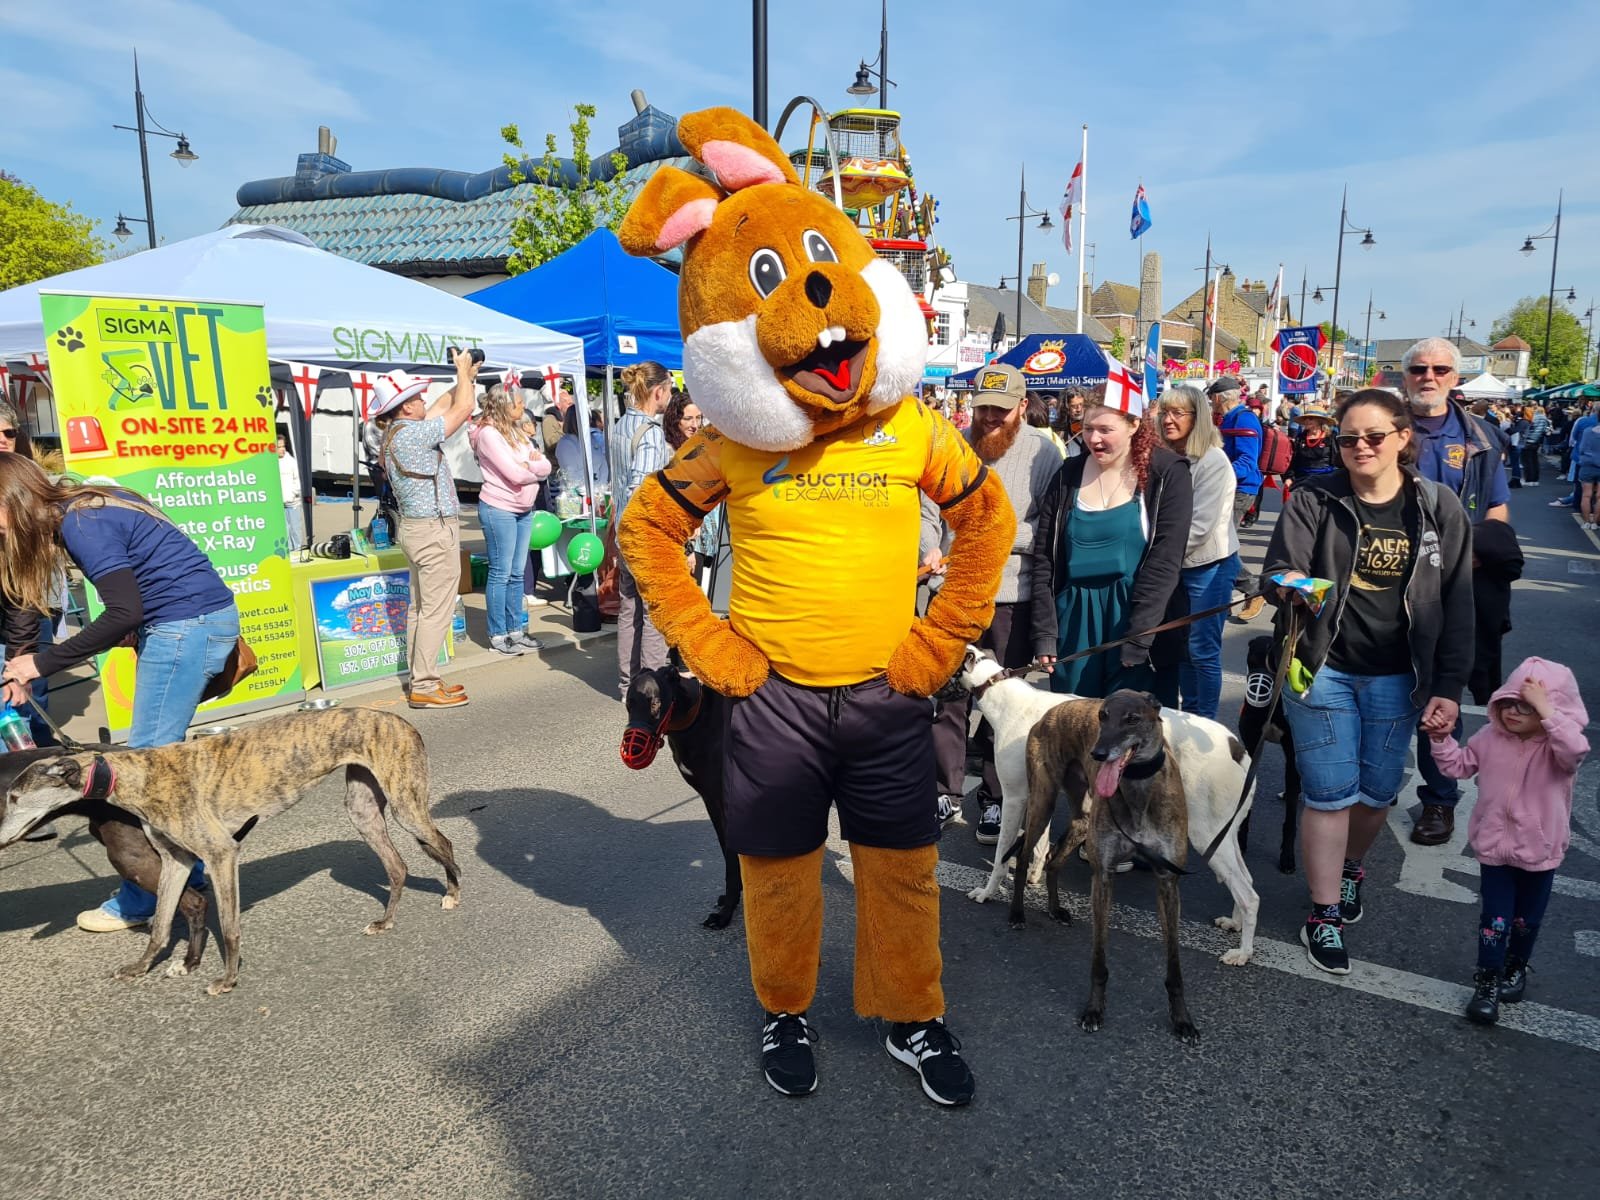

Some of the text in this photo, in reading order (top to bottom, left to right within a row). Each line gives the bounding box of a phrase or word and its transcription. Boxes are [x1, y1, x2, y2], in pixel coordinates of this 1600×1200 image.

[104, 317, 171, 336] SIGMA
[140, 305, 228, 410] VET
[1025, 376, 1045, 385] 1220
[1046, 375, 1081, 386] (March)
[122, 417, 269, 435] ON-SITE 24 HR
[116, 438, 276, 461] Emergency Care
[155, 470, 257, 489] Affordable
[795, 473, 888, 487] SUCTION
[147, 488, 267, 508] Health Plans
[785, 487, 889, 501] EXCAVATION
[177, 514, 265, 535] ate of the
[203, 534, 256, 552] X-Ray
[1359, 536, 1410, 554] SALEM
[1366, 552, 1401, 570] 1692
[216, 563, 258, 578] ouse
[226, 578, 271, 595] stics
[349, 582, 409, 601] May & June
[239, 603, 289, 619] avet.co.uk
[241, 619, 293, 634] 1354 553457
[247, 630, 295, 645] 354 553459
[344, 637, 408, 657] 30% OFF DEN
[255, 650, 296, 666] igh Street
[339, 651, 408, 675] 15% OFF NEUTE
[252, 666, 279, 677] March
